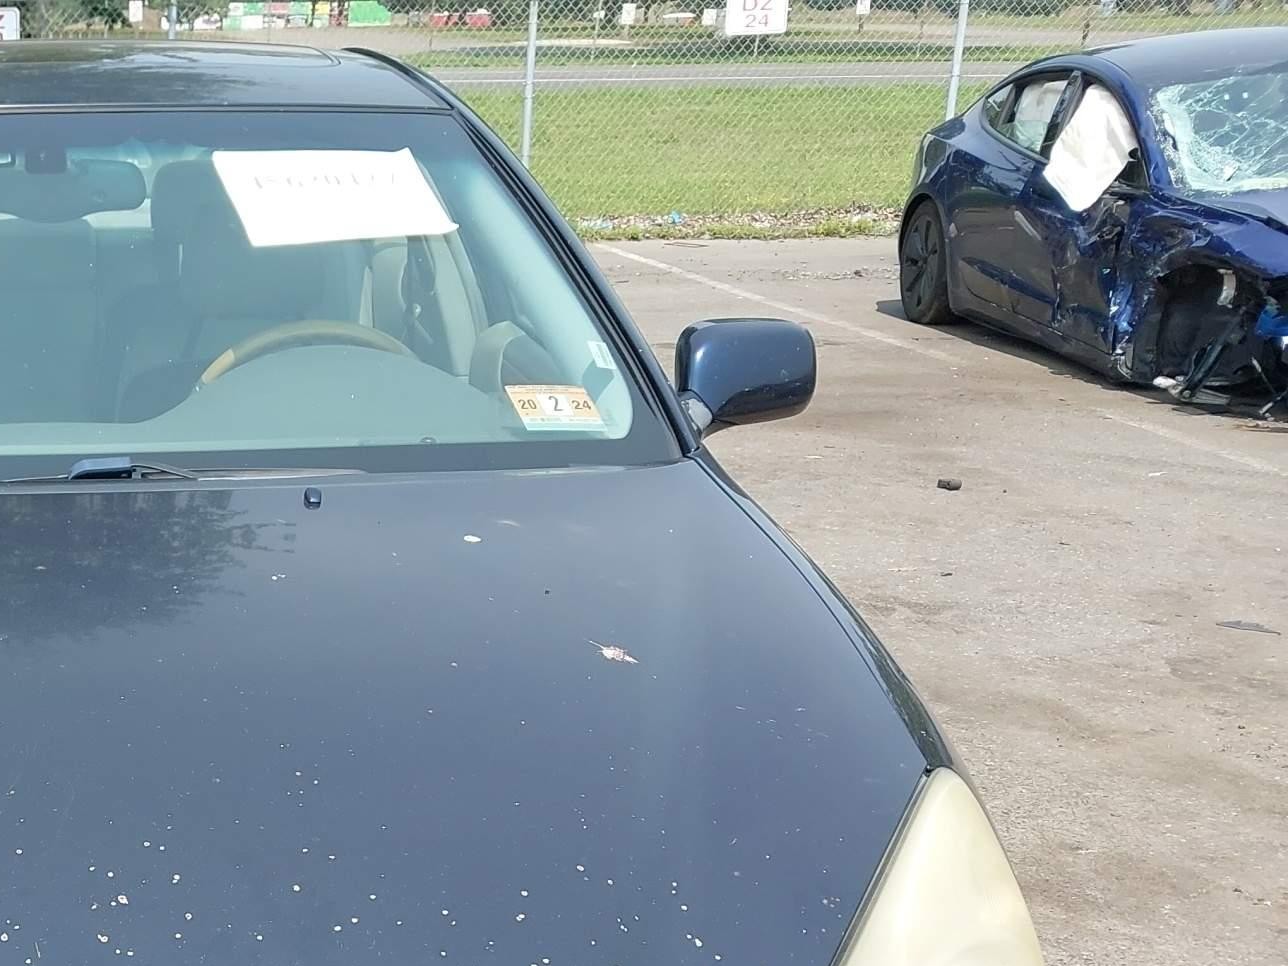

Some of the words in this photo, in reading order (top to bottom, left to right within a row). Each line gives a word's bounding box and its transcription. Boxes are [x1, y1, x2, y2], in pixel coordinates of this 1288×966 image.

[744, 13, 769, 28] 24
[518, 398, 538, 411] 20
[548, 395, 564, 412] 2
[571, 399, 592, 411] 24
